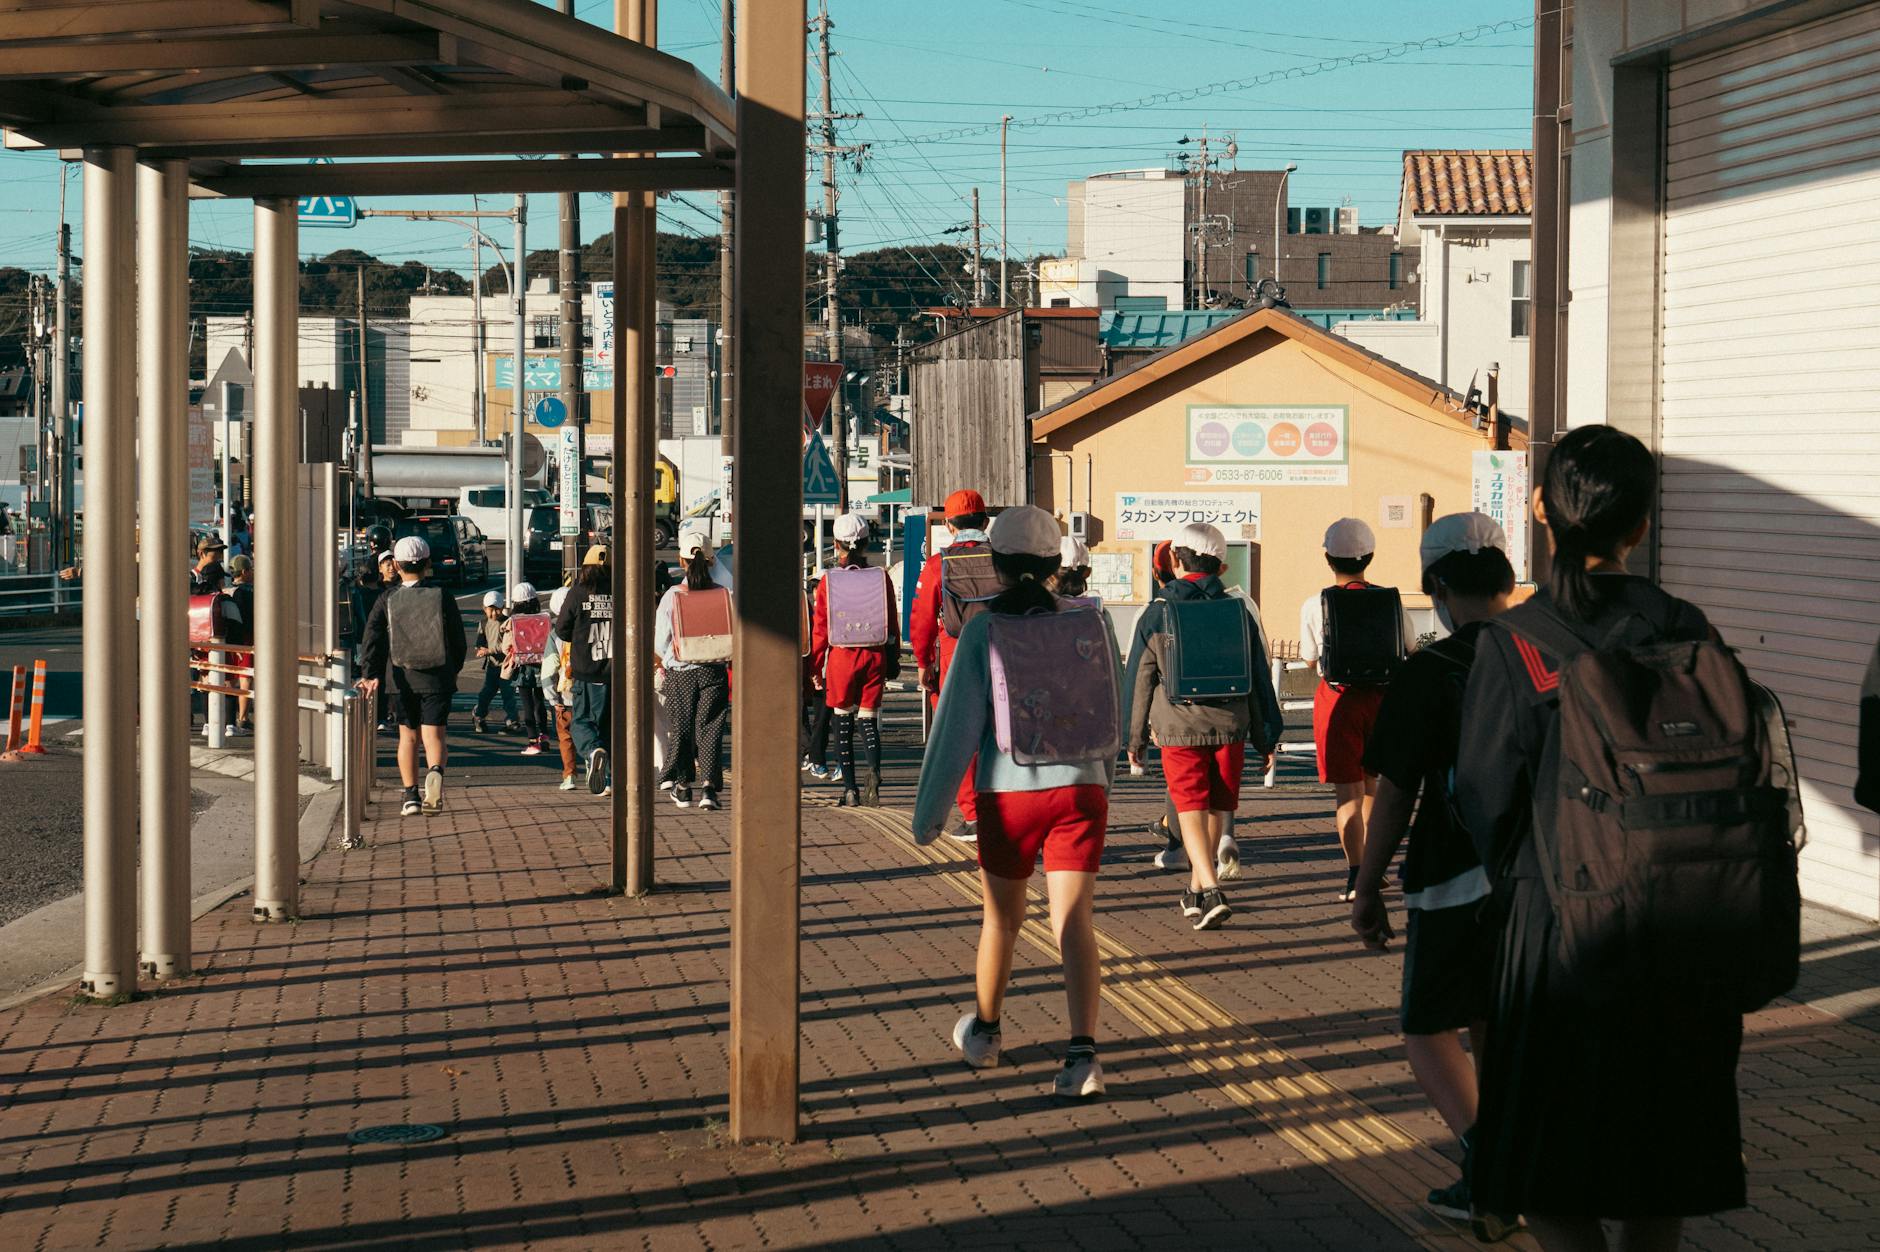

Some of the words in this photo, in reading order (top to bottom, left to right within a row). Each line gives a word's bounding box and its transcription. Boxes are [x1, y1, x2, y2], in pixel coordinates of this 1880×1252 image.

[804, 374, 834, 389] 止まれ
[1215, 469, 1283, 481] 0533-87-6006
[1120, 510, 1259, 523] タカシマプロジェクト
[582, 602, 592, 611] IS
